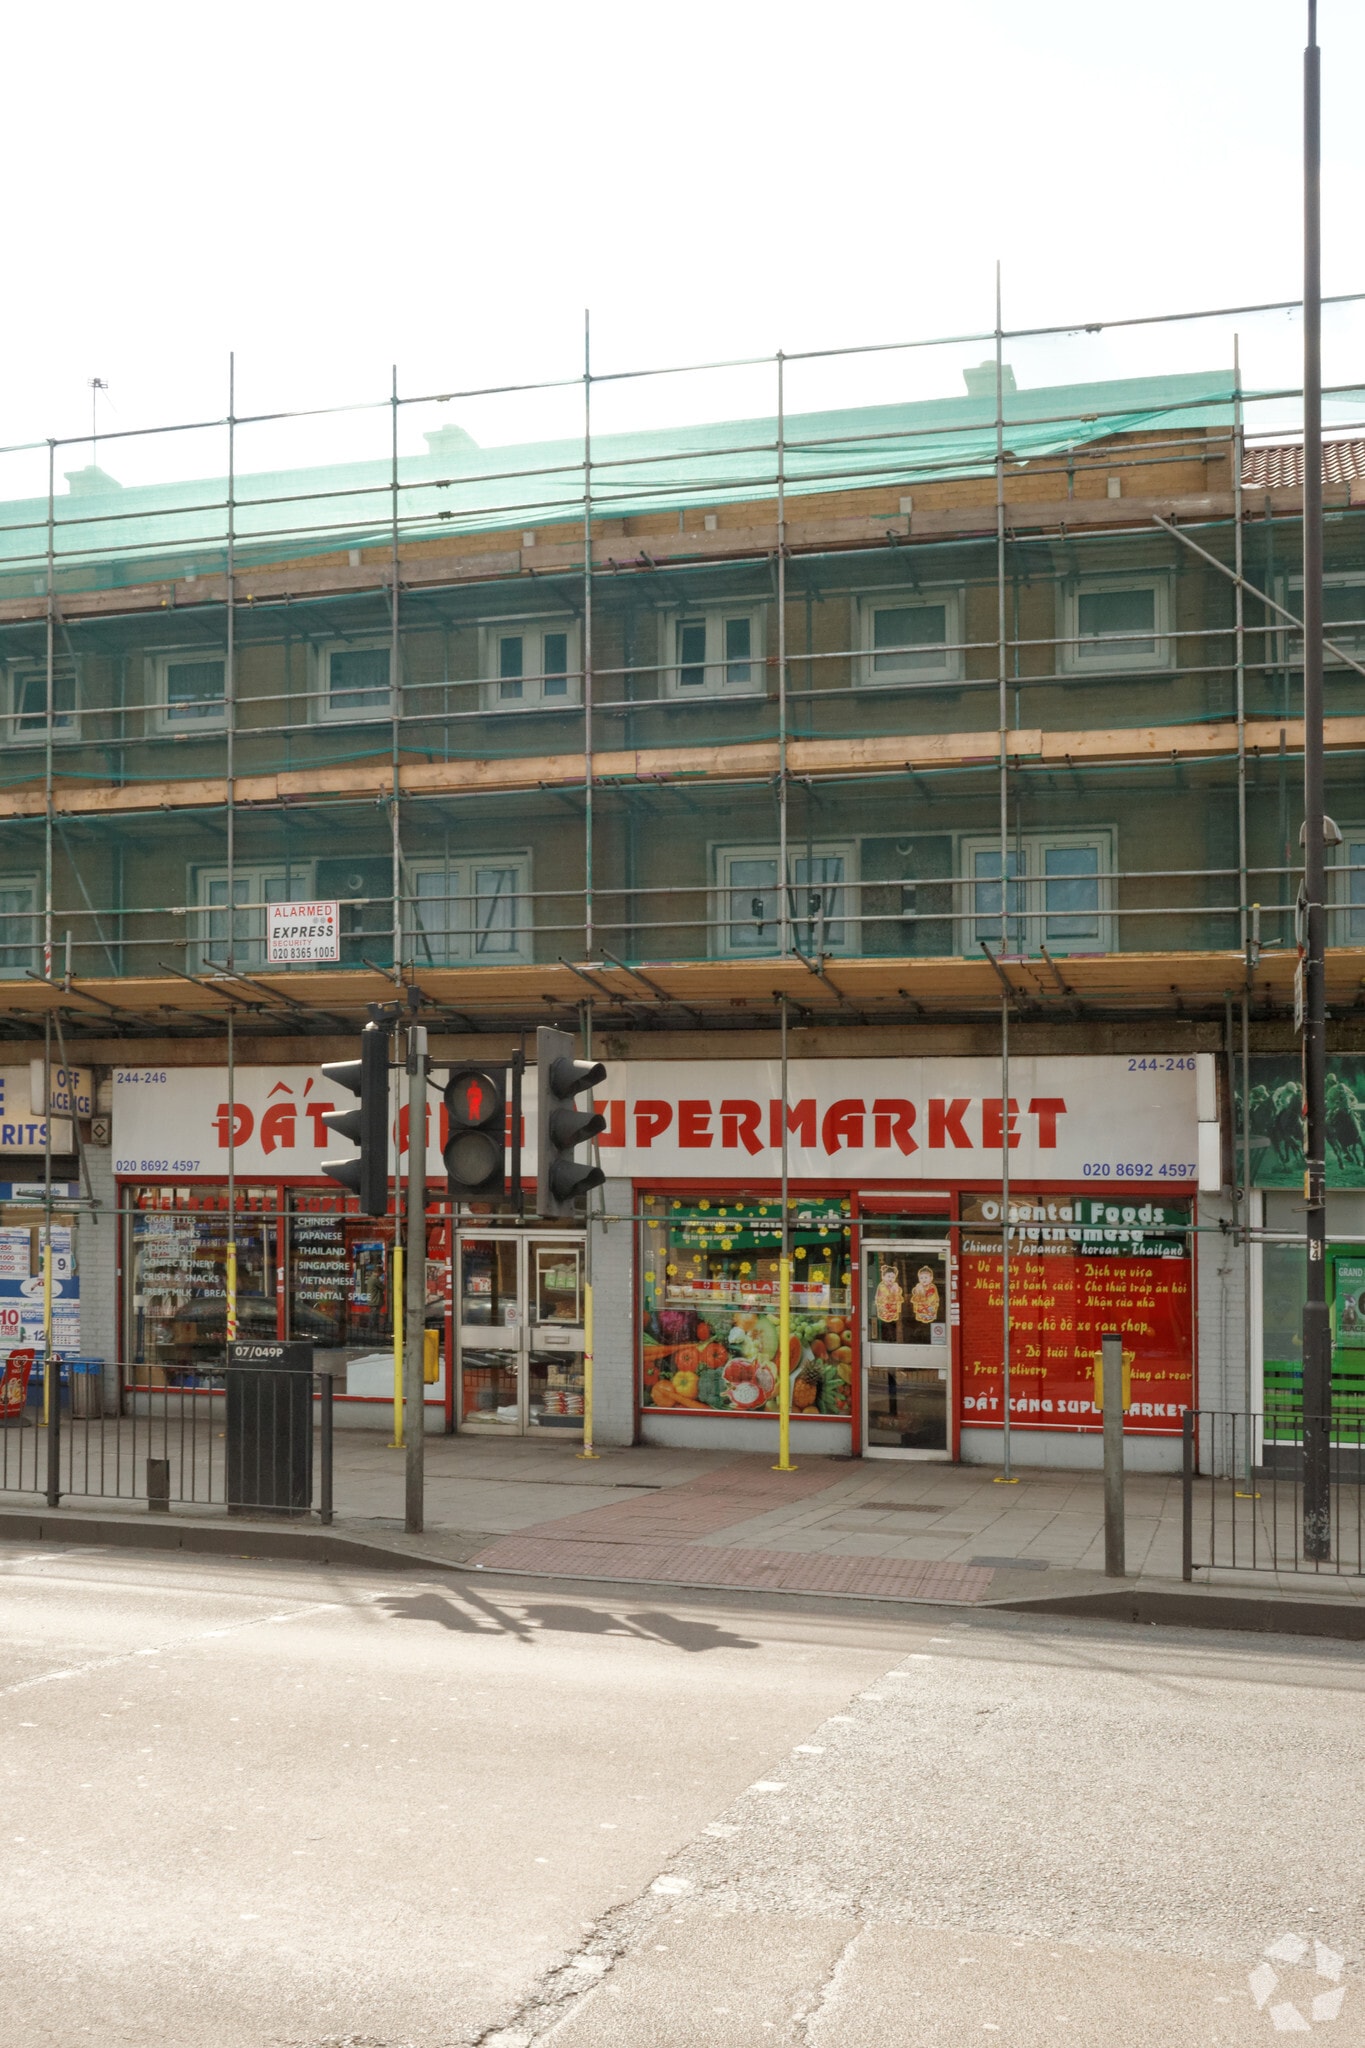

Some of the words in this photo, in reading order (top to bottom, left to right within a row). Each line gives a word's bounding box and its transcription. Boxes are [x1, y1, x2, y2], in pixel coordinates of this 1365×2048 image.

[274, 905, 332, 917] ALARMED
[273, 925, 334, 939] EXPRESS
[272, 939, 312, 947] SECURITY
[273, 948, 288, 959] 020
[290, 947, 311, 959] 8365
[314, 946, 335, 958] 1005
[1128, 1058, 1196, 1071] 244-246
[117, 1072, 167, 1084] 244-246
[593, 1098, 1067, 1156] UPERMARKET
[116, 1160, 137, 1171] 020
[140, 1160, 168, 1171] 8692
[172, 1160, 200, 1171] 4597
[1083, 1163, 1110, 1177] 020
[1116, 1163, 1153, 1177] 8692
[1158, 1163, 1196, 1176] 4597
[137, 1196, 272, 1211] VIETNAMESE
[1091, 1202, 1165, 1224] Foods
[144, 1215, 196, 1224] CIGARETTES
[298, 1217, 335, 1226] CHINESE
[299, 1231, 342, 1241] JAPANESE
[143, 1244, 197, 1253] HOUSEHOLD
[298, 1246, 346, 1256] THAILAND
[962, 1240, 1003, 1253] Chinese
[1016, 1240, 1067, 1256] Japanese
[1131, 1242, 1183, 1256] Thailand
[143, 1258, 216, 1268] CONFECTIONERY
[298, 1261, 350, 1271] SINGAPORE
[1025, 1262, 1045, 1276] bay
[1130, 1266, 1153, 1277] visa
[1338, 1267, 1363, 1277] GRAND
[143, 1273, 170, 1281] CRISPS
[185, 1274, 220, 1282] SNACKS
[299, 1276, 354, 1286] VIETNAMESE
[1009, 1279, 1020, 1293] ặt
[1084, 1280, 1102, 1292] Cho
[1106, 1281, 1127, 1292] thuê
[142, 1287, 169, 1296] FRESH
[171, 1288, 192, 1297] MILK
[204, 1289, 227, 1298] BREA
[299, 1291, 344, 1301] ORIENTAL
[347, 1293, 372, 1302] SPICE
[1077, 1322, 1091, 1331] xe
[1095, 1322, 1117, 1331] sau
[235, 1346, 284, 1358] 07/049P
[973, 1361, 998, 1375] Free
[1130, 1368, 1152, 1382] king
[1154, 1370, 1166, 1379] at
[1169, 1372, 1192, 1380] rear
